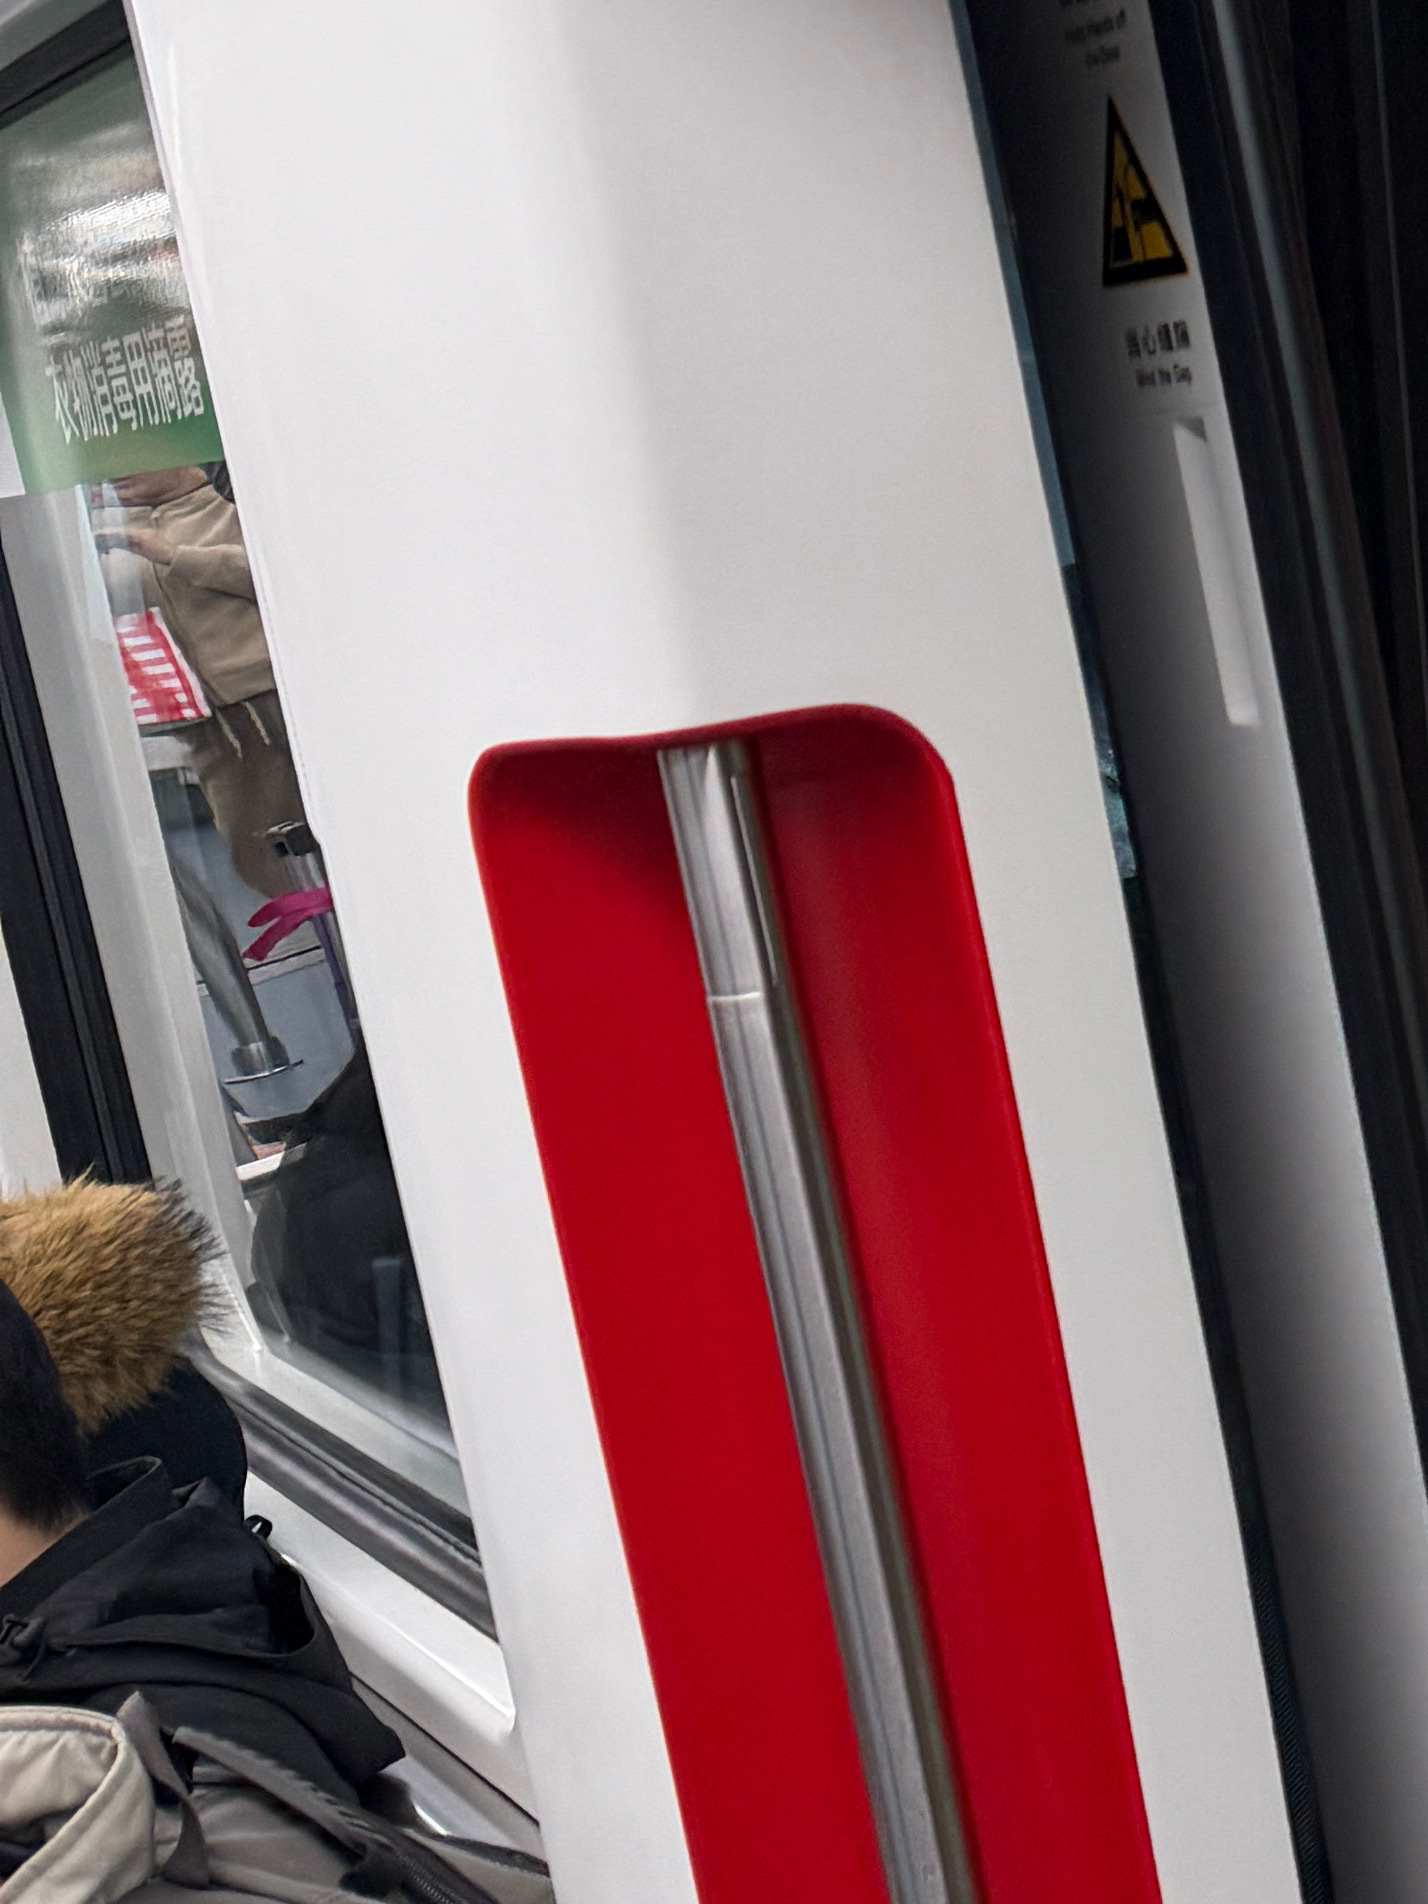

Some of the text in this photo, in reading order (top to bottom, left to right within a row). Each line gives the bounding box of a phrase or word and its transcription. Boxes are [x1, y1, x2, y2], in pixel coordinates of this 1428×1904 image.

[45, 314, 204, 444] 衣物消毒用滴露
